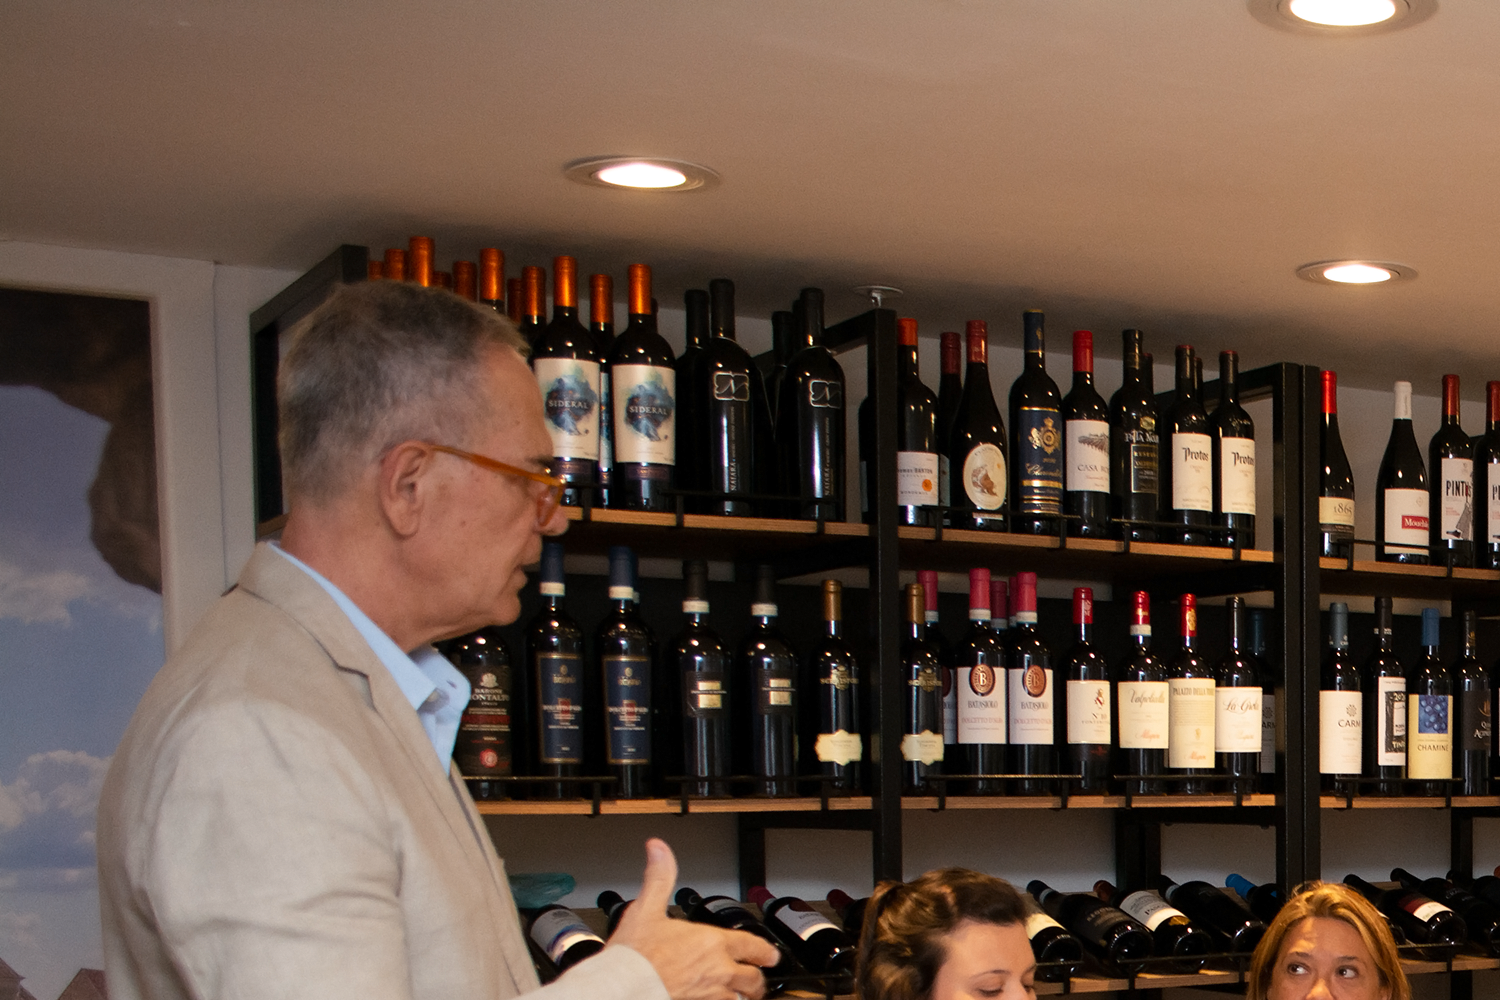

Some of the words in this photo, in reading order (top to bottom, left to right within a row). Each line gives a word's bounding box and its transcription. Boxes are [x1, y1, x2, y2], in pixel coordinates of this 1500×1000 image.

[548, 400, 588, 410] SIDERAL
[629, 406, 668, 415] SIDERAL
[1182, 447, 1209, 463] Protos
[1077, 464, 1099, 472] CASA
[1334, 503, 1352, 515] 1865
[1172, 687, 1193, 696] PALAZZO
[967, 700, 999, 711] BATASIOLO
[1020, 701, 1049, 711] BATASIOLO
